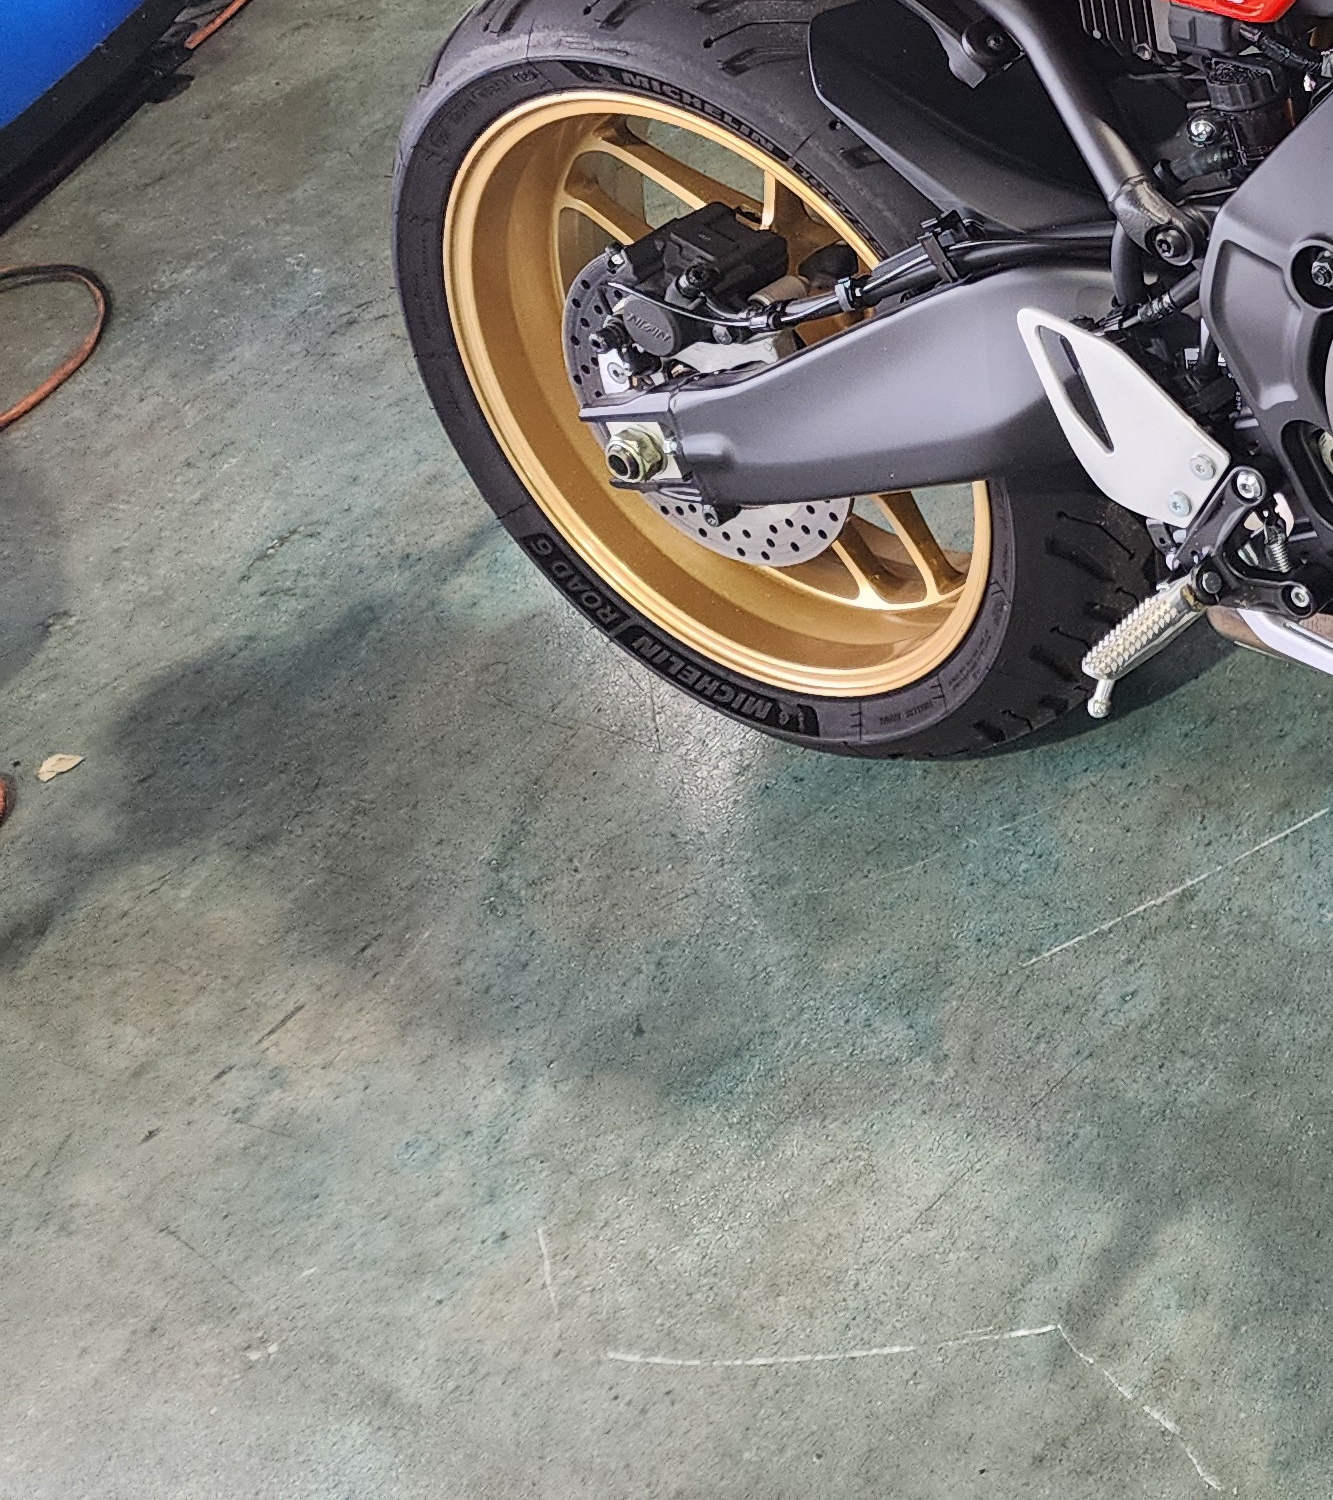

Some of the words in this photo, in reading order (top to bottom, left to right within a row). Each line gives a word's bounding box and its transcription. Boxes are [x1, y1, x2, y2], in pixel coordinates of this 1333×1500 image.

[621, 73, 777, 152] MICHELIN
[528, 537, 553, 558] 6
[552, 560, 619, 629] ROAD
[630, 634, 775, 722] MICHELIN
